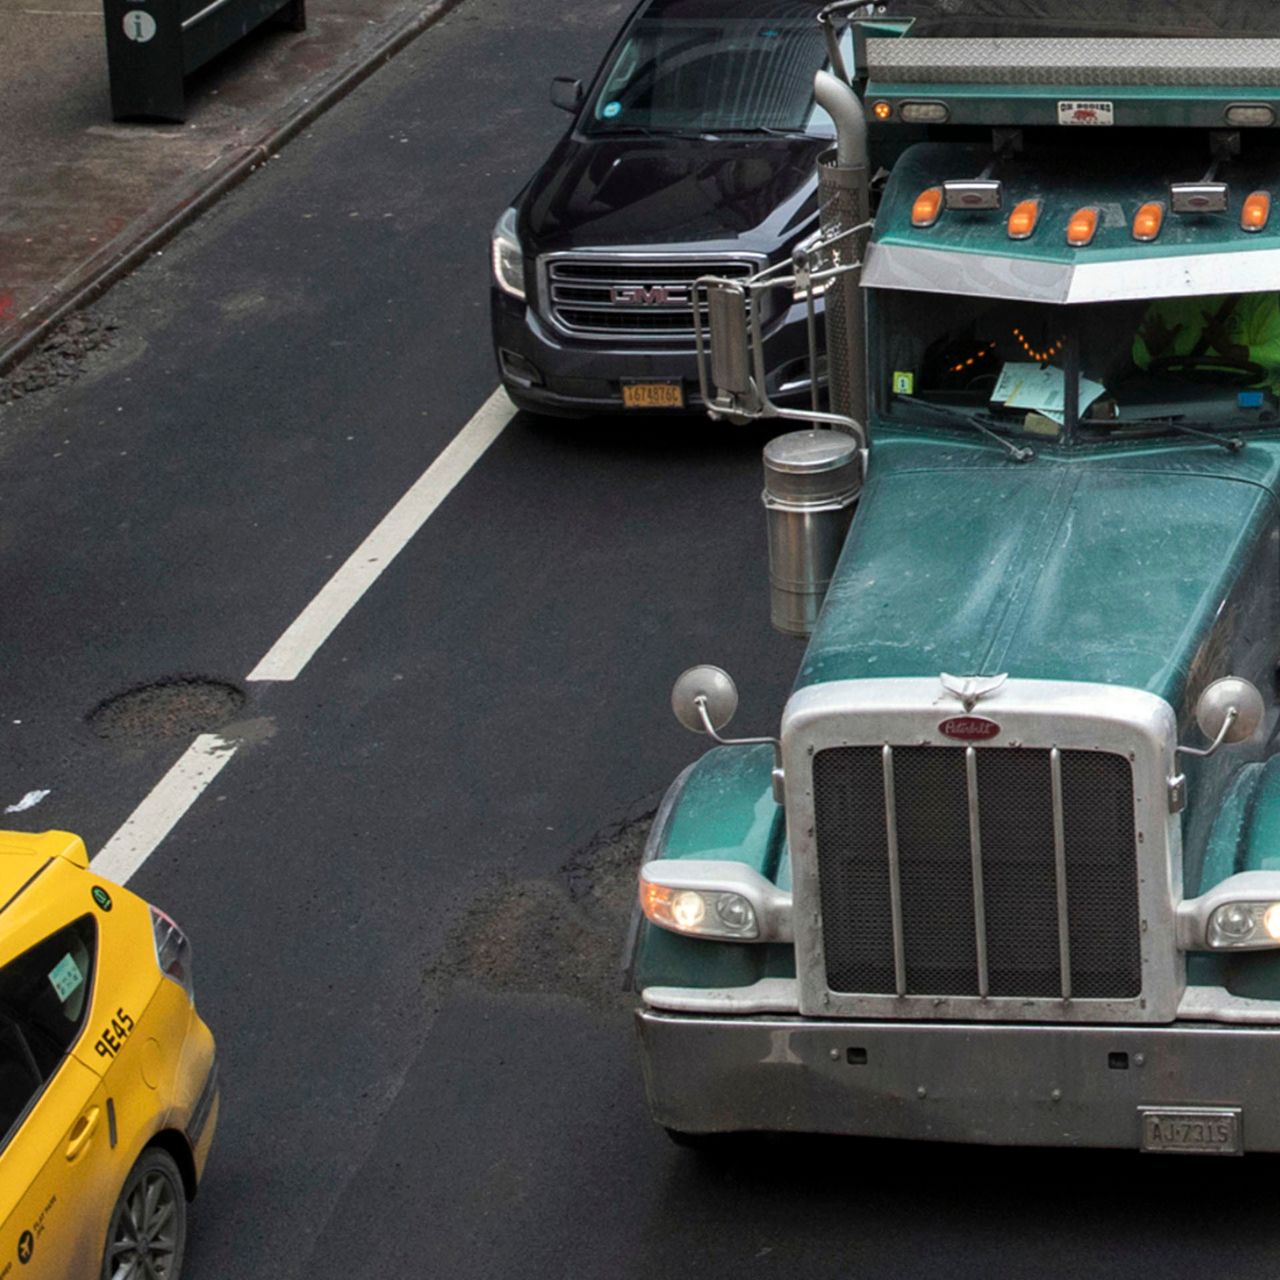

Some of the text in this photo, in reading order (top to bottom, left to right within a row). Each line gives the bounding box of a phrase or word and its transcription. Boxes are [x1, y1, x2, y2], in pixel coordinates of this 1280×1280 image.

[611, 285, 688, 305] GMC
[945, 720, 994, 736] Peterbilt
[94, 1007, 135, 1059] 9E45
